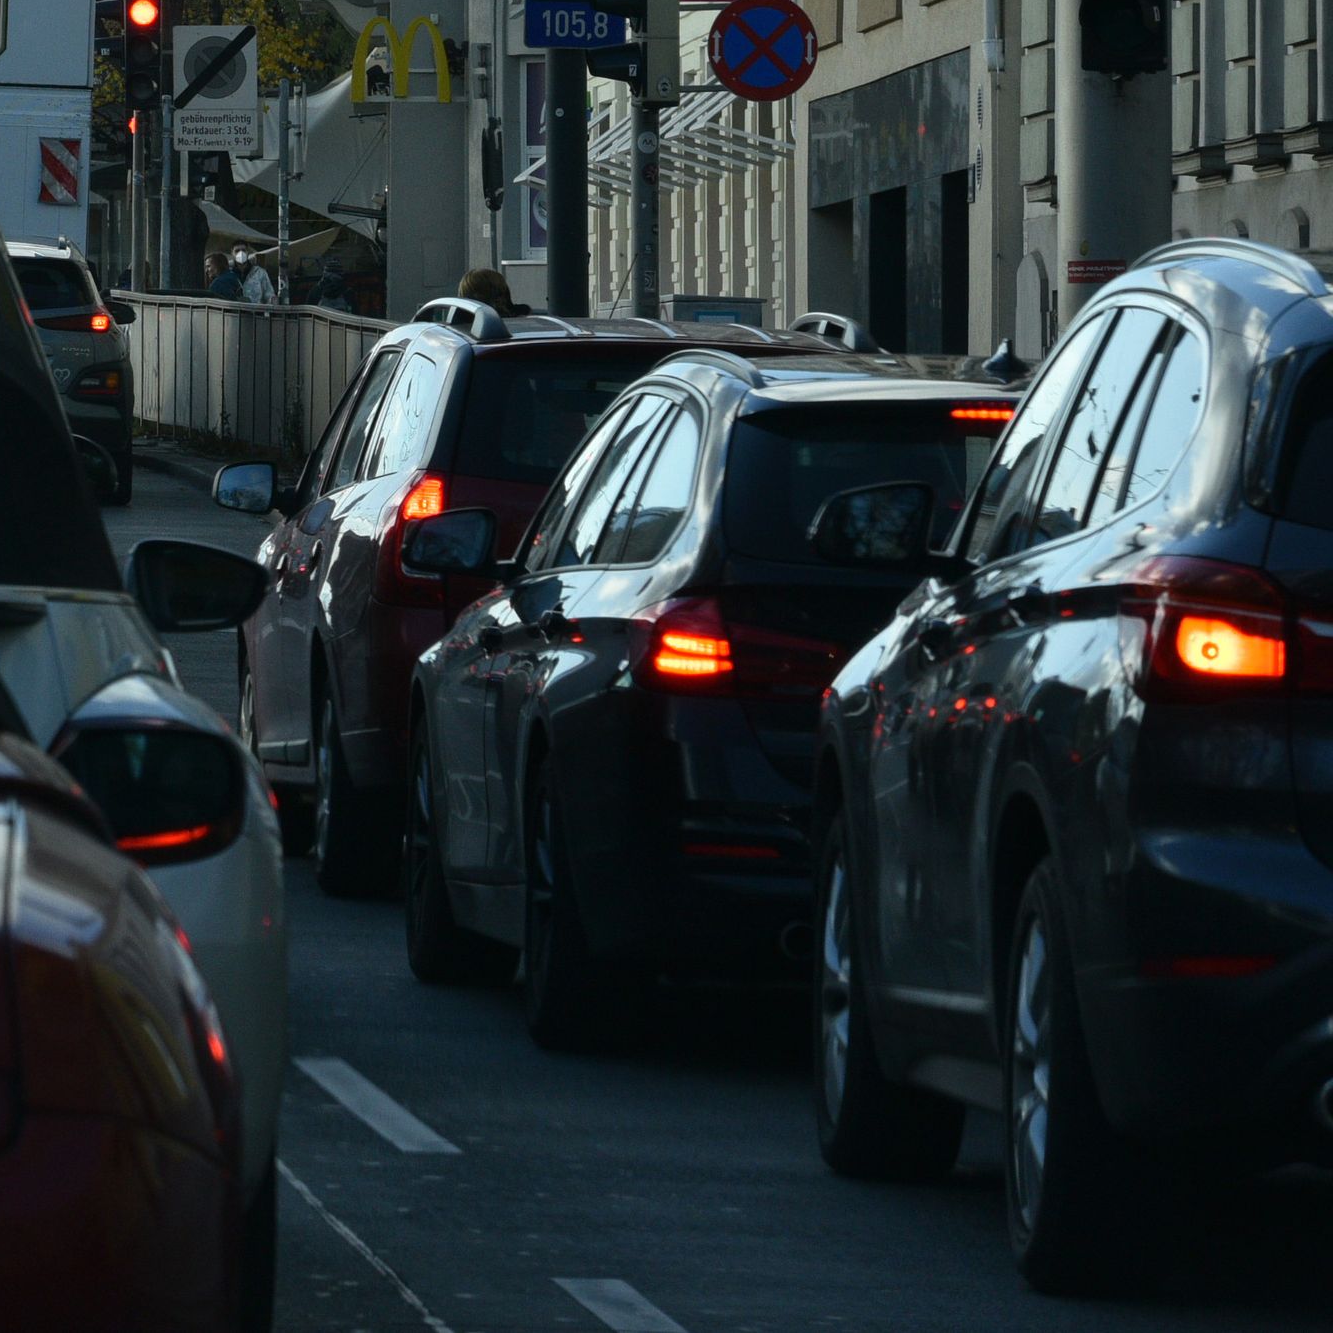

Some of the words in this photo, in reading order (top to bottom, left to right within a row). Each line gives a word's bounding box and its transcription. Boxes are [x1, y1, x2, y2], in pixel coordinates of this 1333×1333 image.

[541, 9, 610, 40] 105,8
[180, 114, 252, 125] gebührenpflichtig
[182, 125, 225, 135] Parkdauer:
[226, 125, 232, 135] 3
[233, 125, 250, 135] Std.
